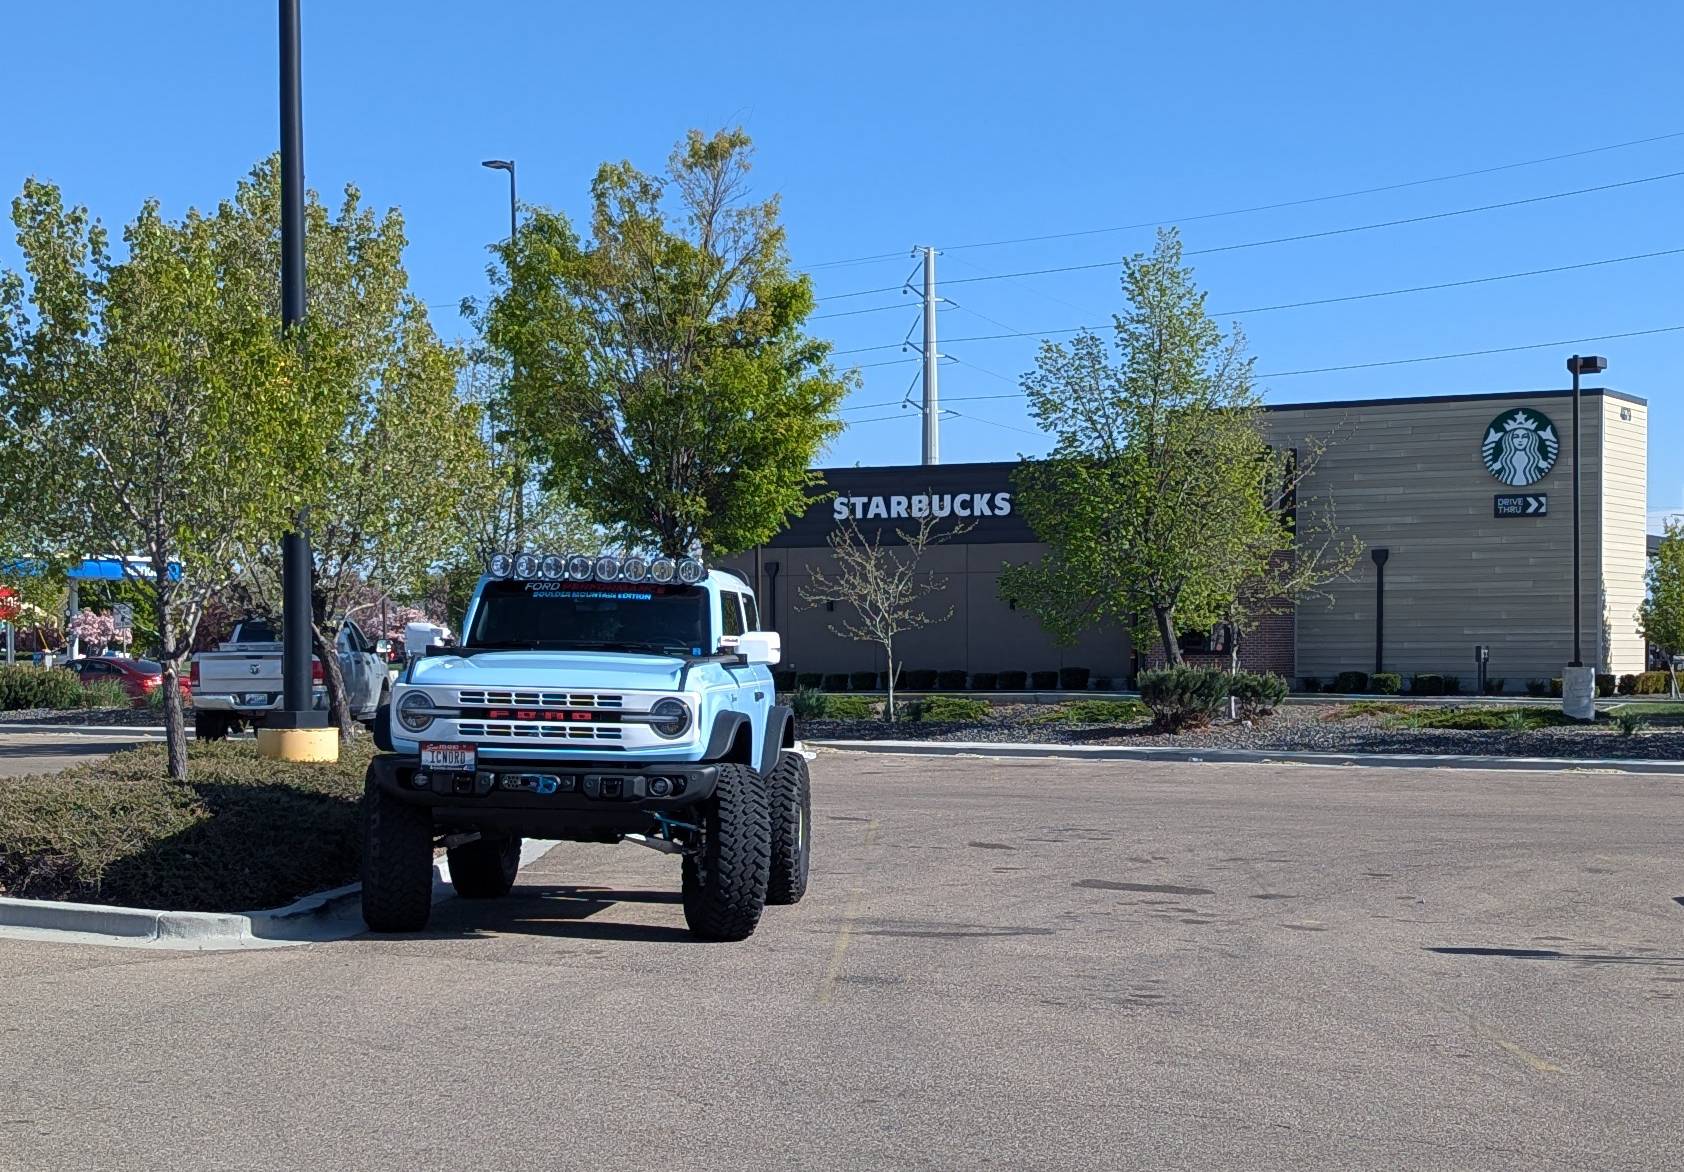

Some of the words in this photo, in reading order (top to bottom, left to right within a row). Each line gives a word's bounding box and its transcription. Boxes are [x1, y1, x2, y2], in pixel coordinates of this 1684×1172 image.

[833, 492, 1011, 520] STARBUCKS
[1497, 498, 1523, 506] DRIVE
[525, 582, 560, 591] FORD
[490, 710, 592, 720] FORD
